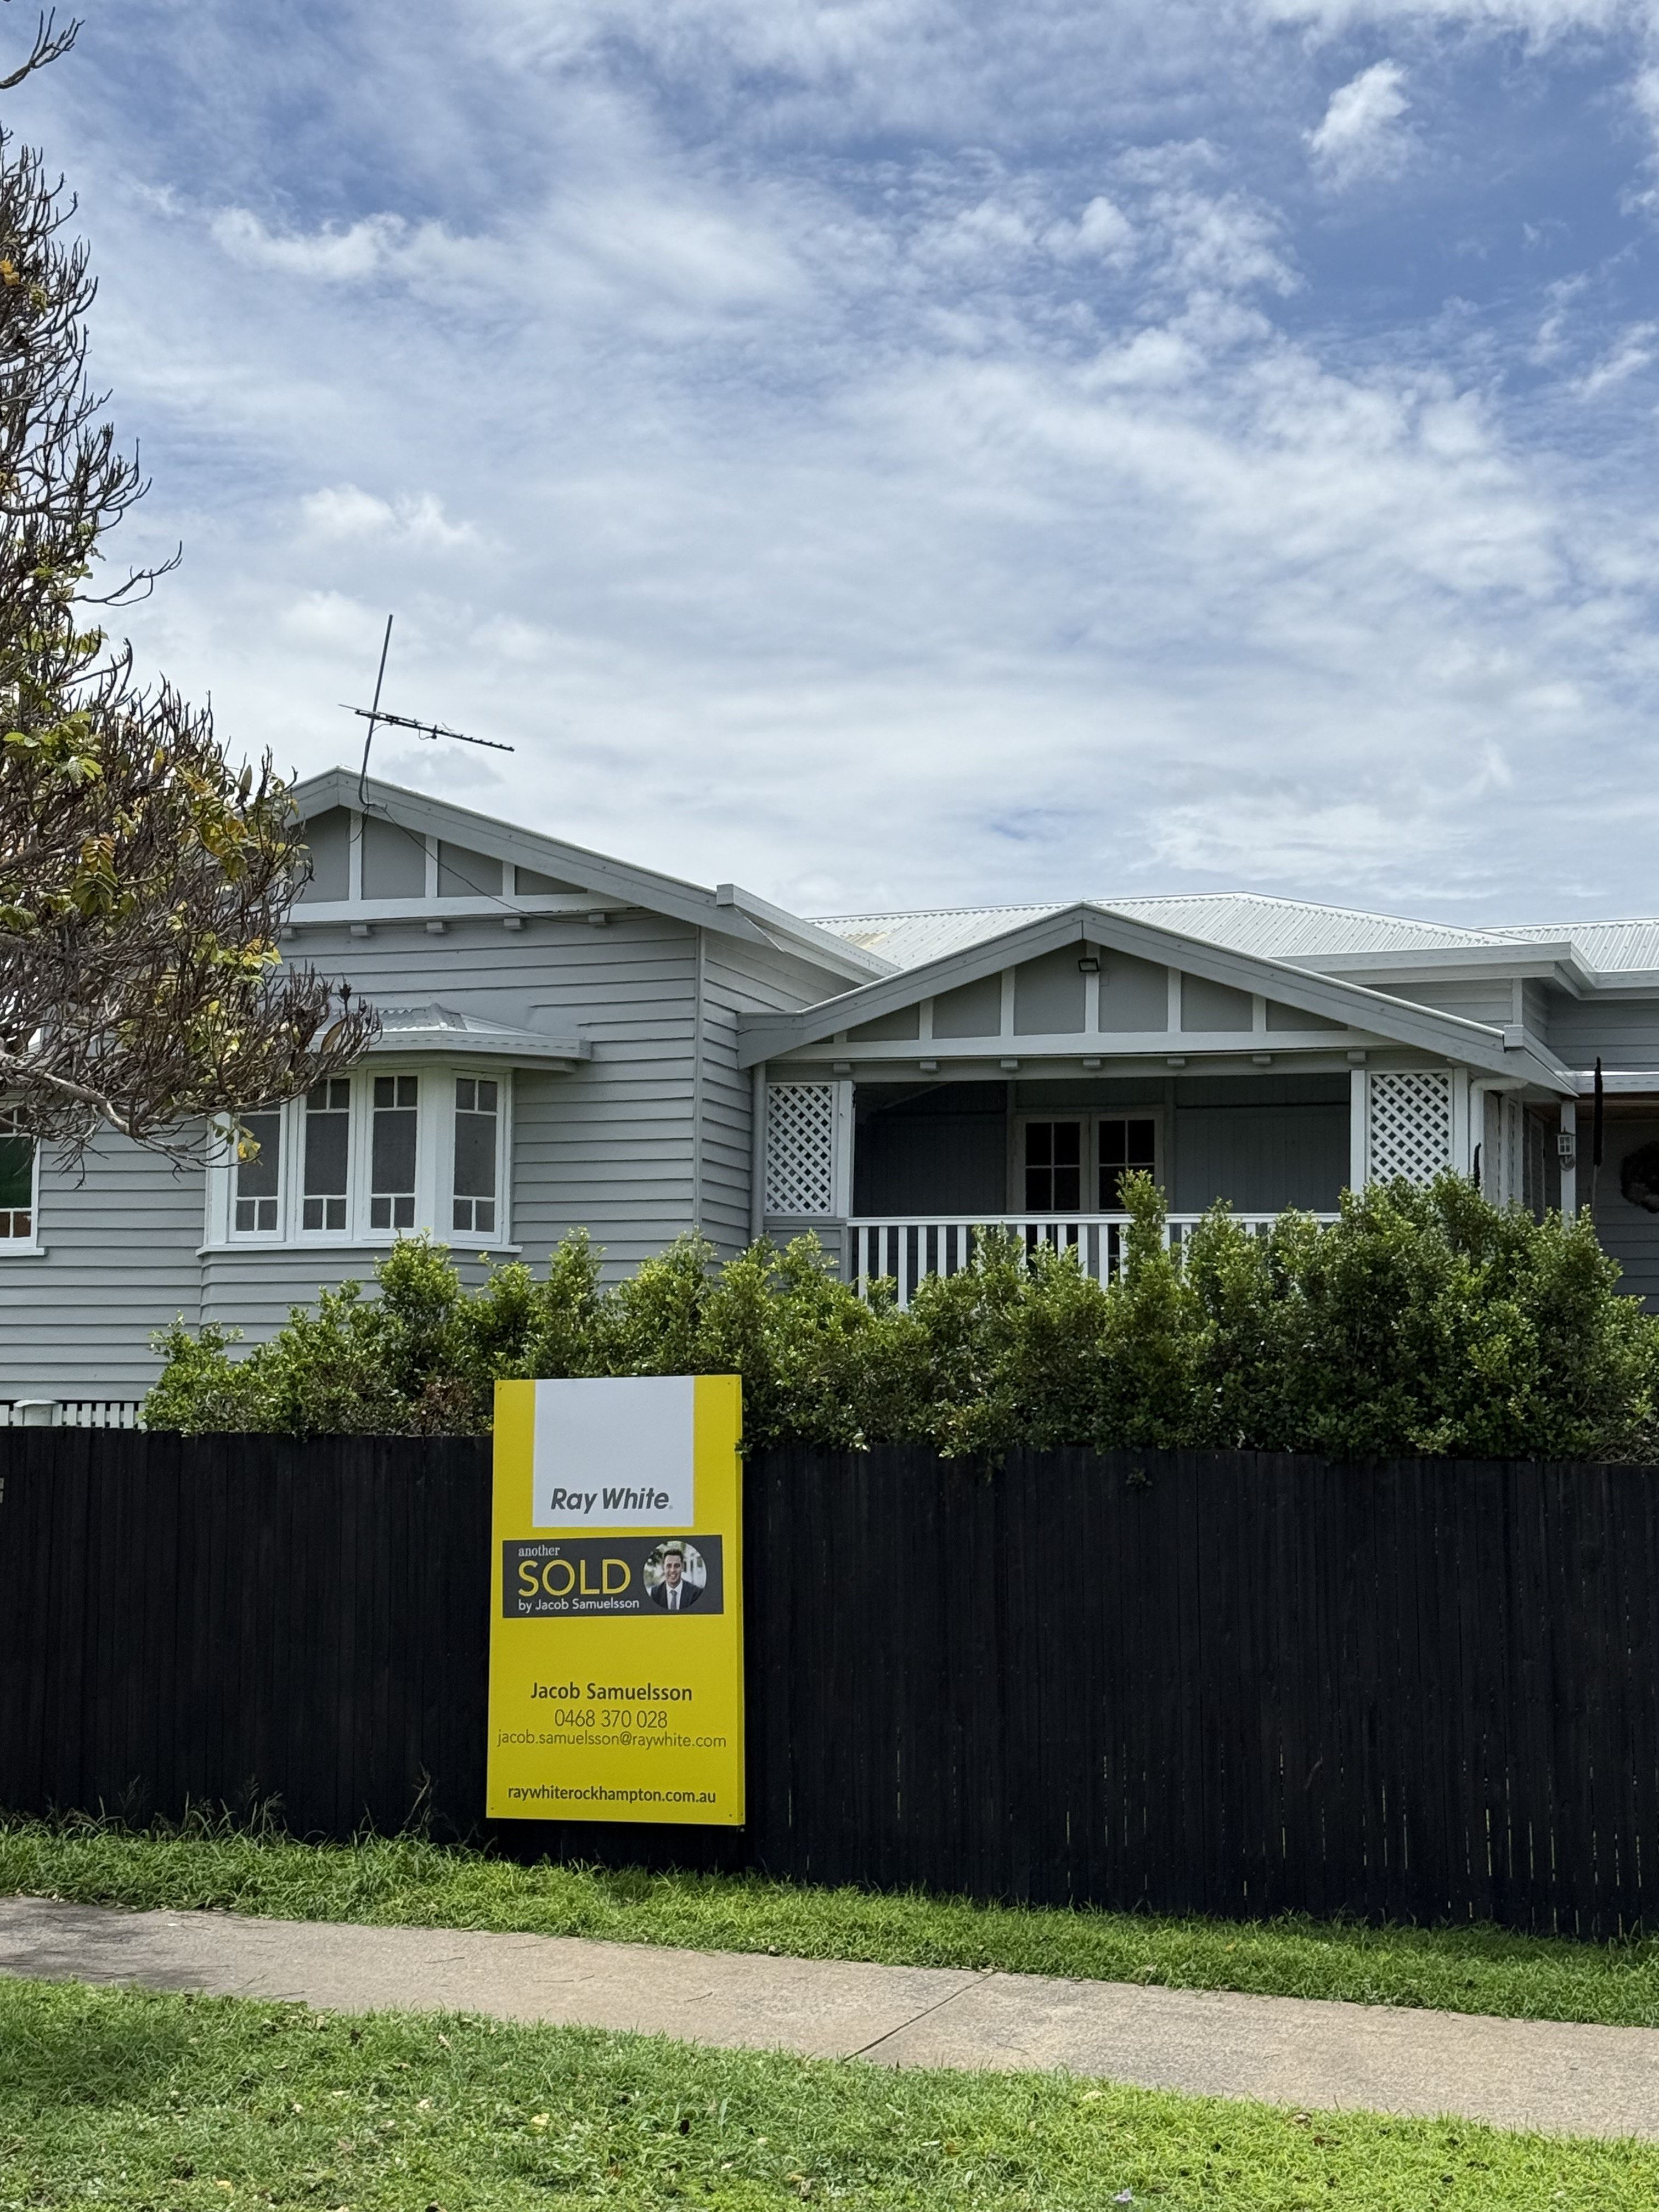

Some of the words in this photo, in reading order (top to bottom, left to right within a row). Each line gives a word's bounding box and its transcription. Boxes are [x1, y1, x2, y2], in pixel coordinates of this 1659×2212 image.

[550, 1488, 597, 1514] Ray
[602, 1488, 669, 1510] White
[518, 1545, 560, 1557] another
[518, 1559, 631, 1597] SOLD
[518, 1599, 532, 1613] by
[535, 1599, 569, 1611] Jacob
[572, 1597, 639, 1610] Samuelsson
[531, 1681, 580, 1700] Jacob
[586, 1683, 692, 1701] Samuelsson
[555, 1709, 595, 1727] 0468
[601, 1709, 631, 1728] 370
[636, 1711, 668, 1728] 028
[497, 1729, 726, 1750] jacob.samuelsson@raywhite.com
[507, 1785, 716, 1803] raywhiterockhampton.com.au
